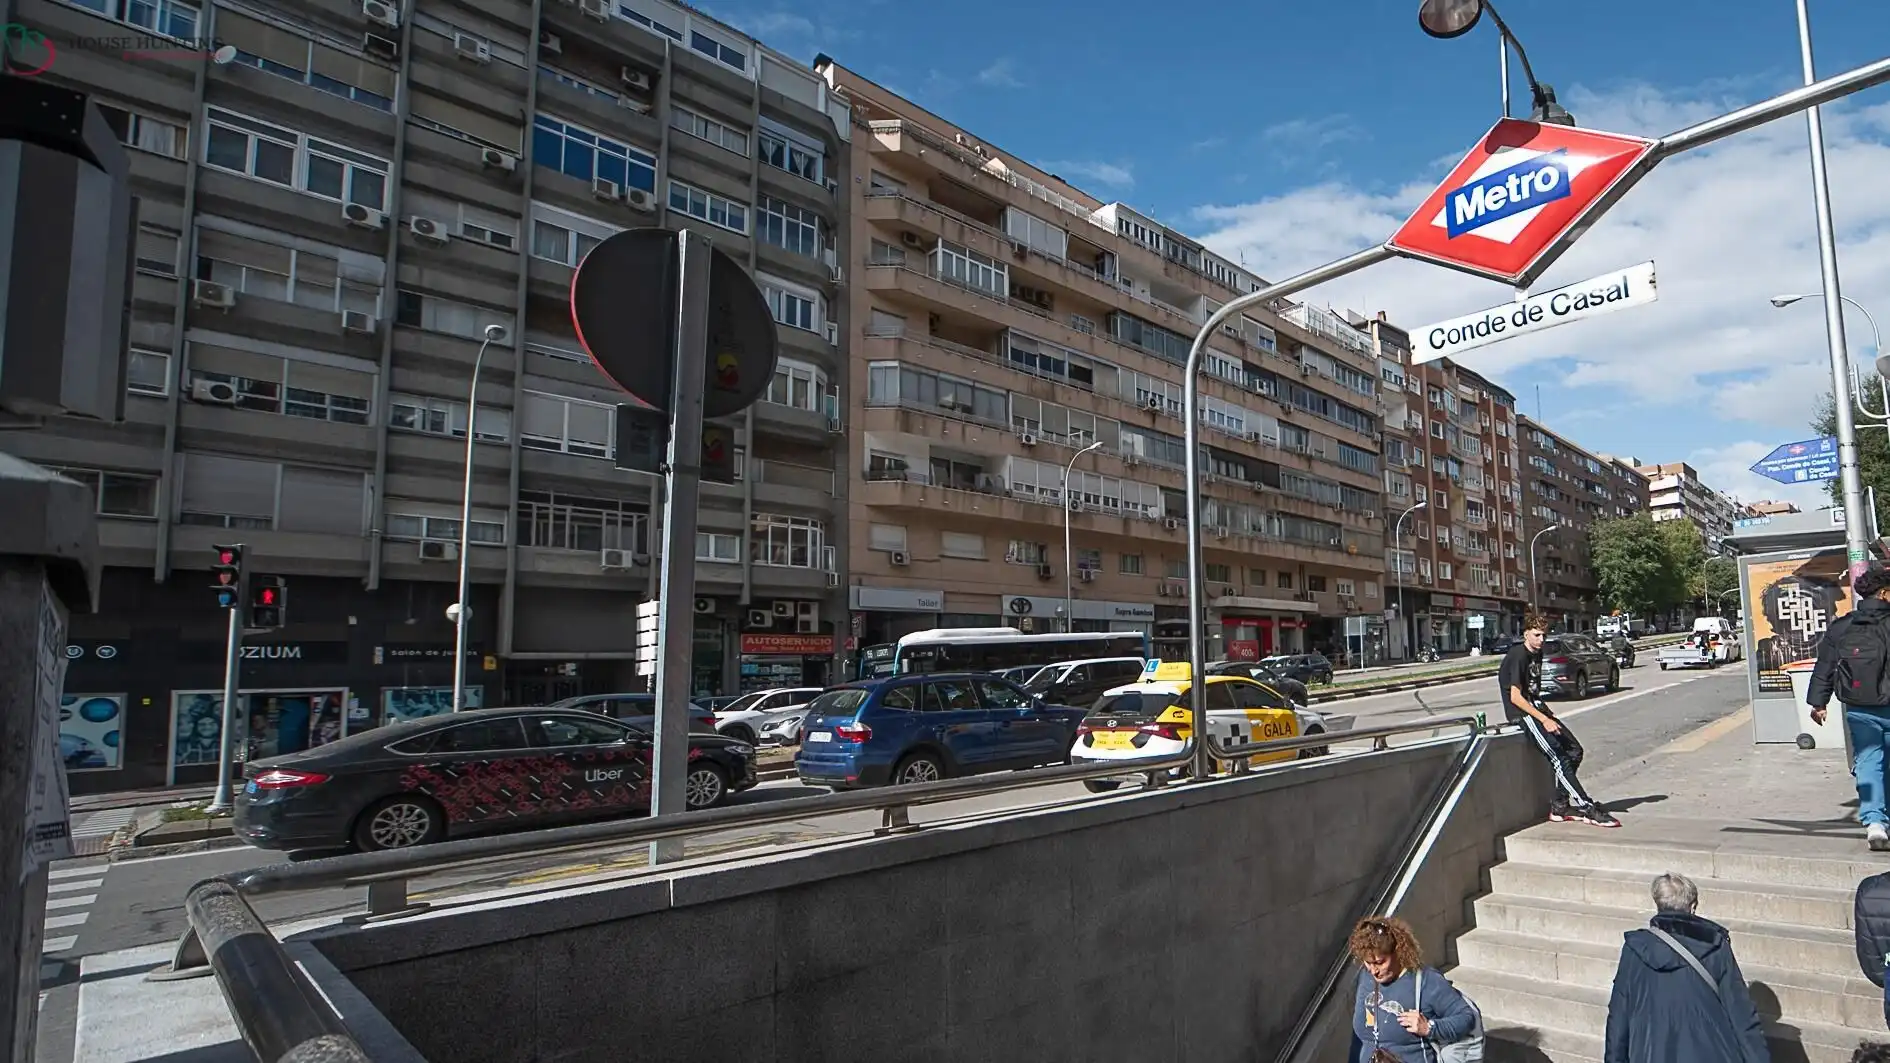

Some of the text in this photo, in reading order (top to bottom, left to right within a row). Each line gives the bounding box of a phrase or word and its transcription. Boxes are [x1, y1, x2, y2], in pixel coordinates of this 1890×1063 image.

[1454, 166, 1561, 226] Metro
[1428, 275, 1630, 351] Conde de Casal
[1782, 461, 1802, 470] Conde
[1818, 470, 1838, 478] Casal
[745, 636, 832, 646] AUTOSERVICIO
[1263, 721, 1292, 738] GALA
[585, 769, 623, 782] Uber
